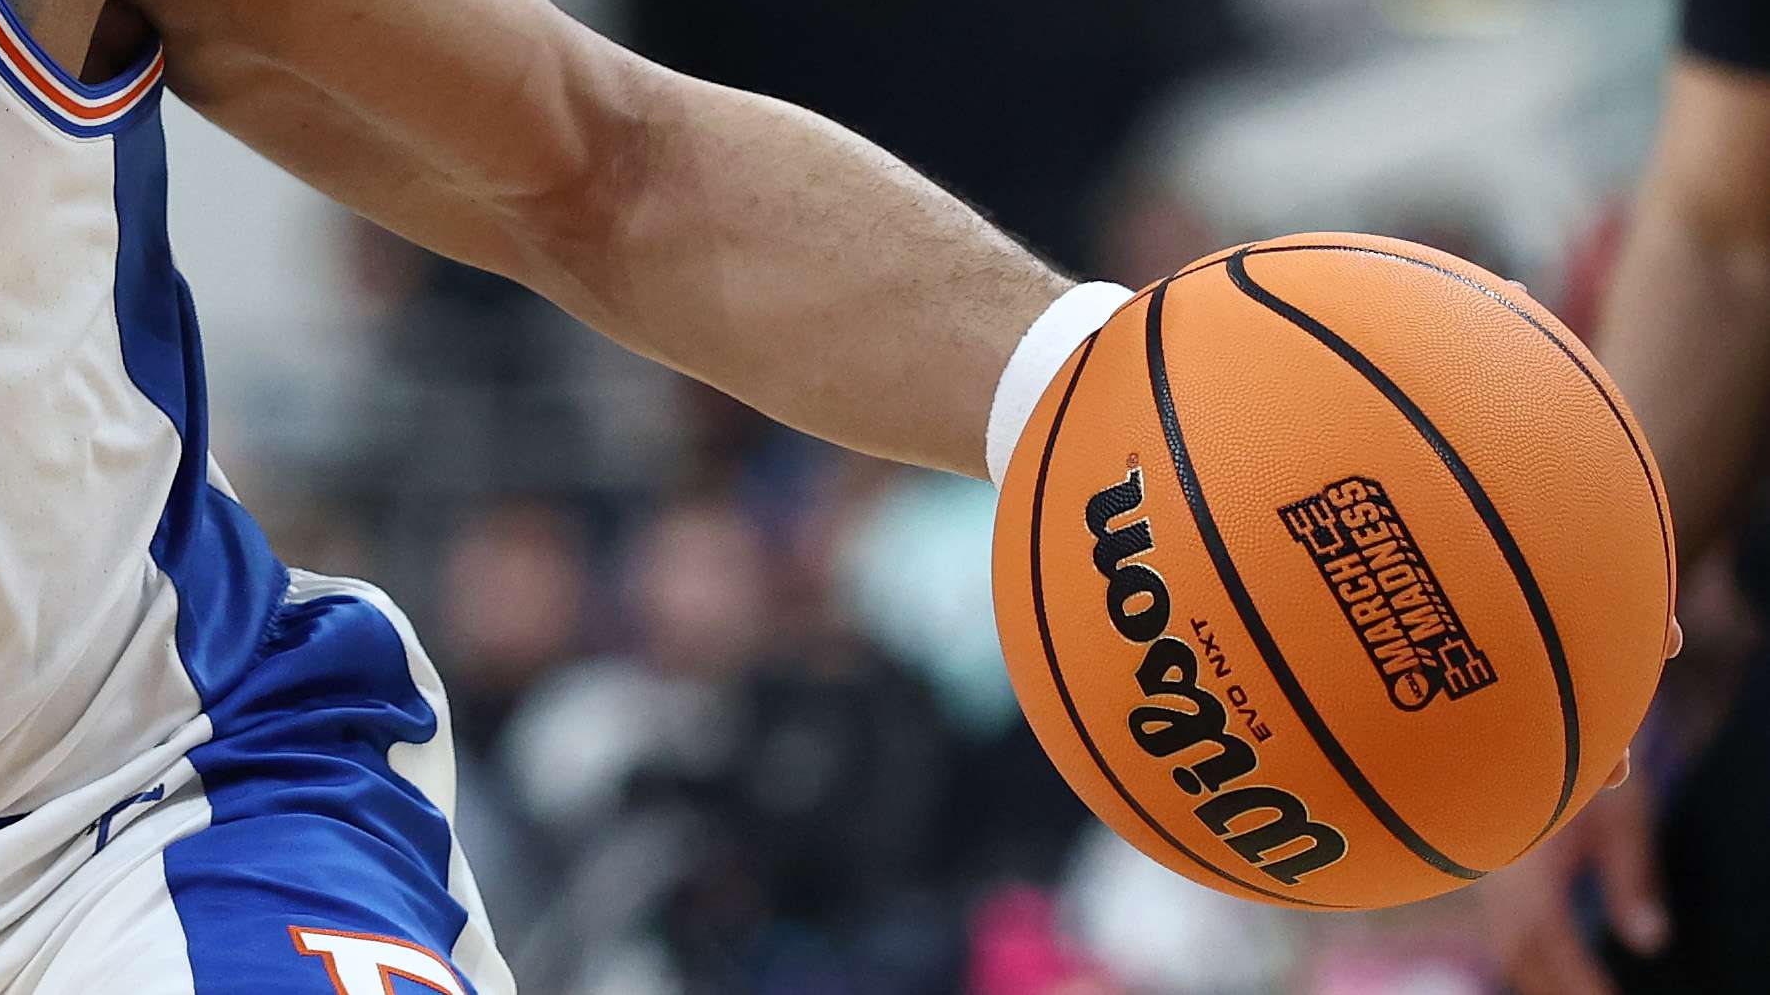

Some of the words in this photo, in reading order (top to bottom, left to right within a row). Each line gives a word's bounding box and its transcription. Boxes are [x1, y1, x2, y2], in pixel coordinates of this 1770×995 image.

[1324, 553, 1419, 675] MARCH
[1328, 480, 1446, 642] MADNESS
[1084, 467, 1349, 886] Wilson
[1191, 618, 1231, 677] NXT
[1226, 685, 1272, 742] EVO
